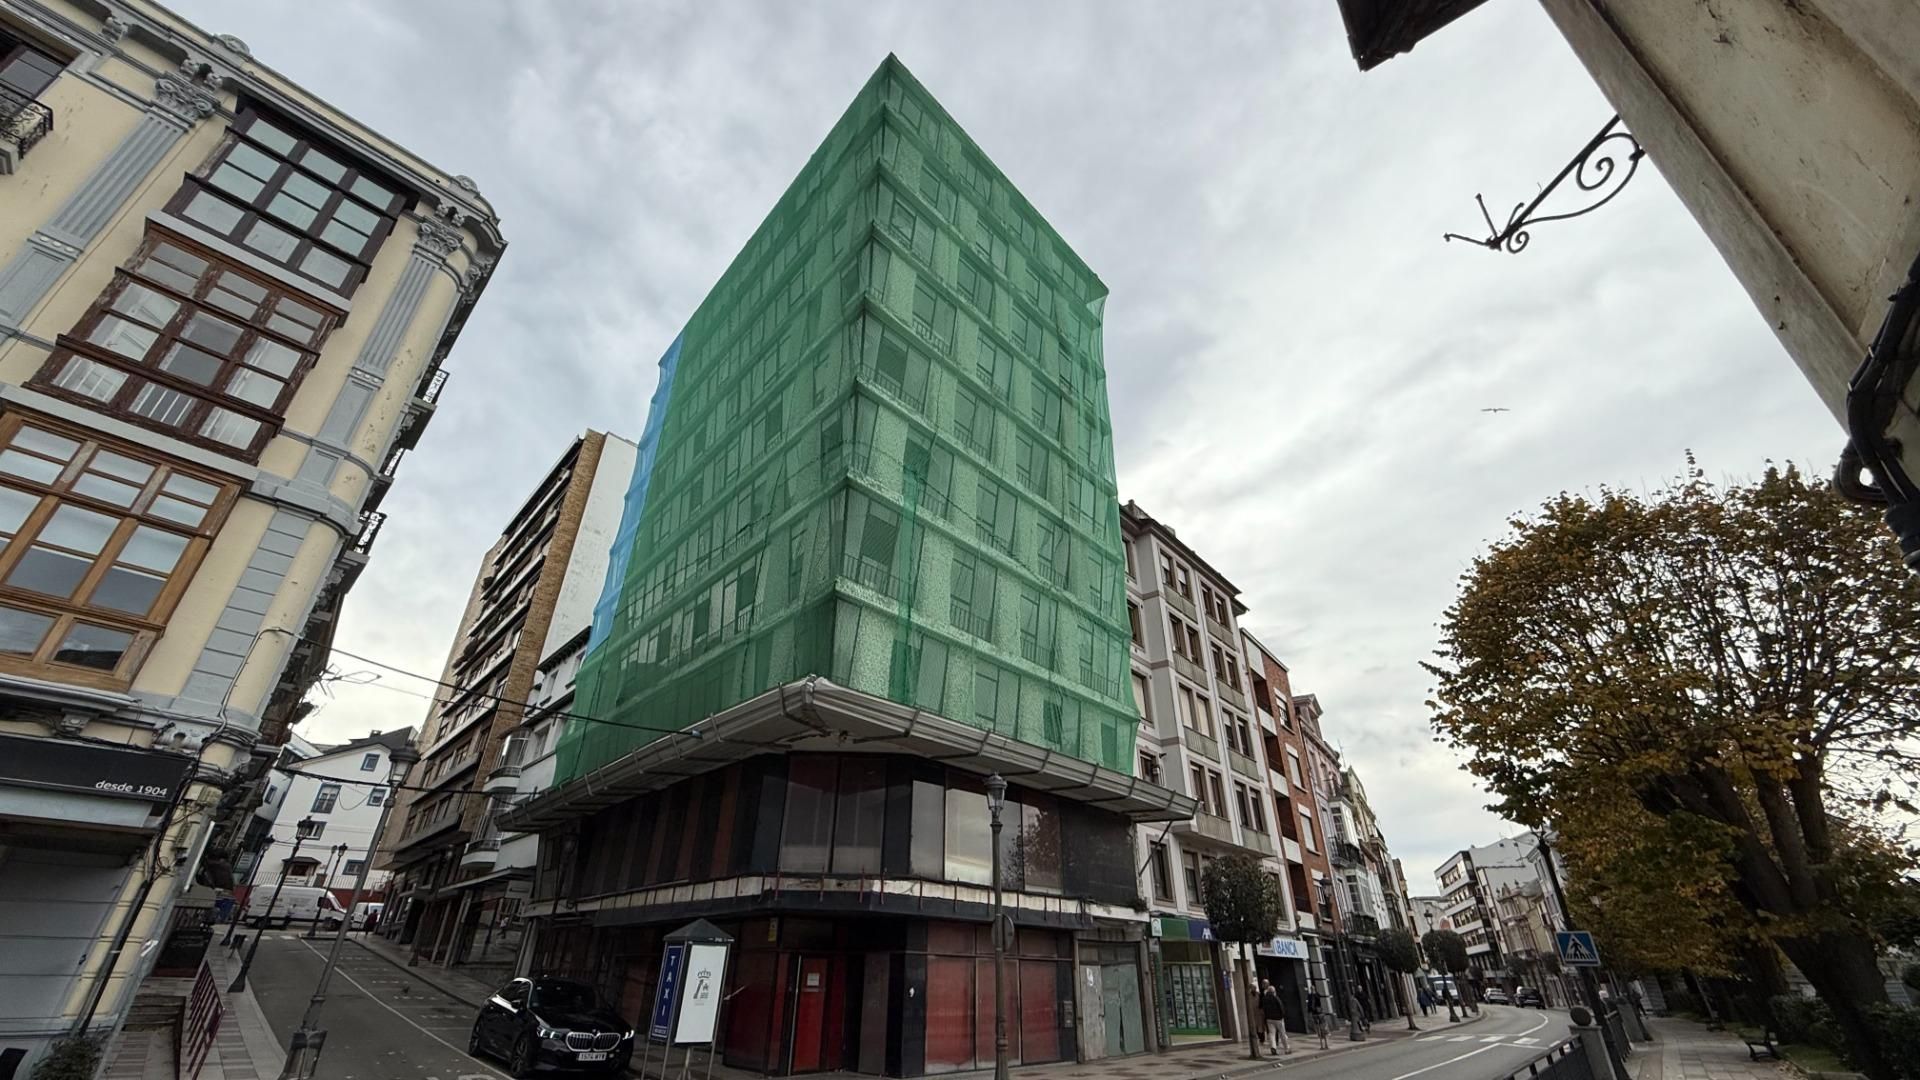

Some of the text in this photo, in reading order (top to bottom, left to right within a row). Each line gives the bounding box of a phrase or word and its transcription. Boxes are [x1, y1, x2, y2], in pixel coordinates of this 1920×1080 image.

[96, 780, 168, 796] desde 1904
[661, 955, 676, 1017] TAXI
